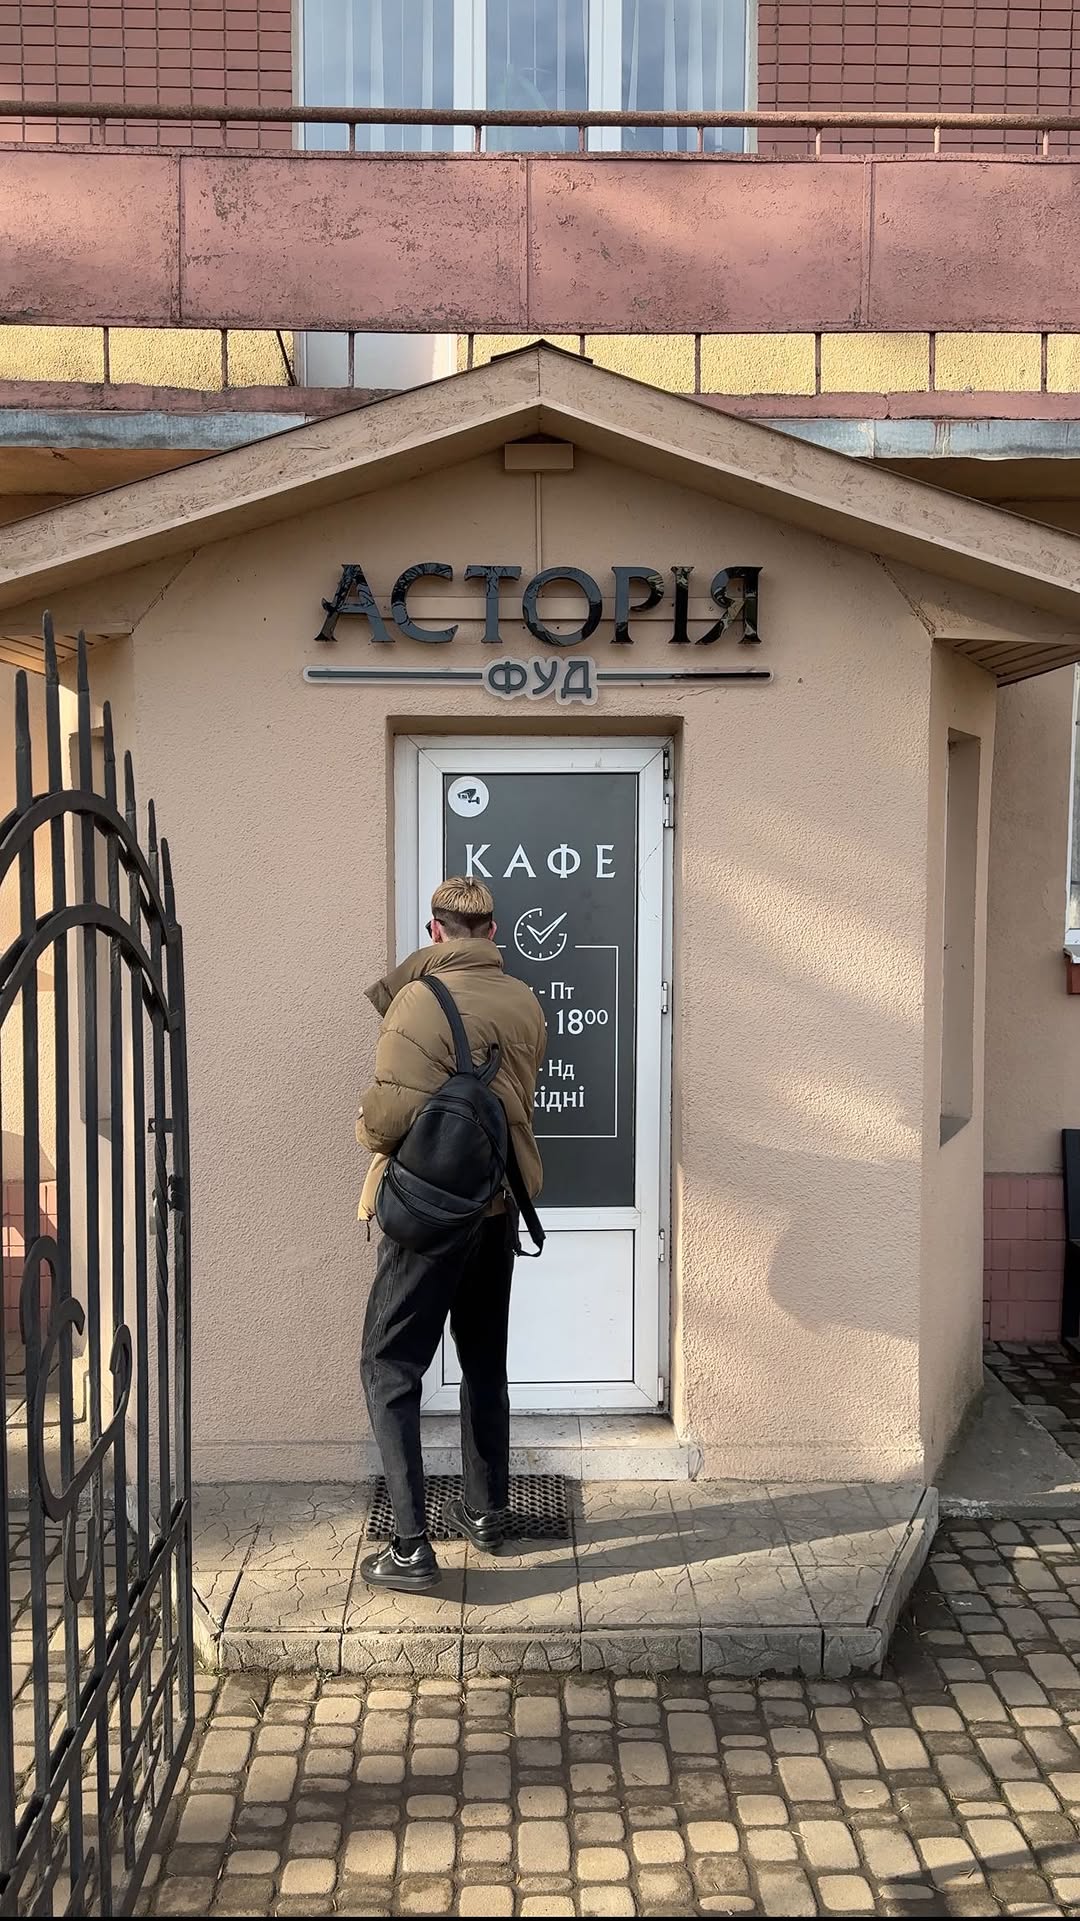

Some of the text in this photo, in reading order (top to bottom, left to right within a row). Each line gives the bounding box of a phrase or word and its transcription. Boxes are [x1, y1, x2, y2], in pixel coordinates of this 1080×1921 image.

[313, 562, 764, 648] АСТОРІЯ
[488, 661, 593, 699] ФУД
[465, 844, 616, 879] КАФЕ
[551, 982, 574, 999] Пт
[549, 1060, 575, 1080] Нд
